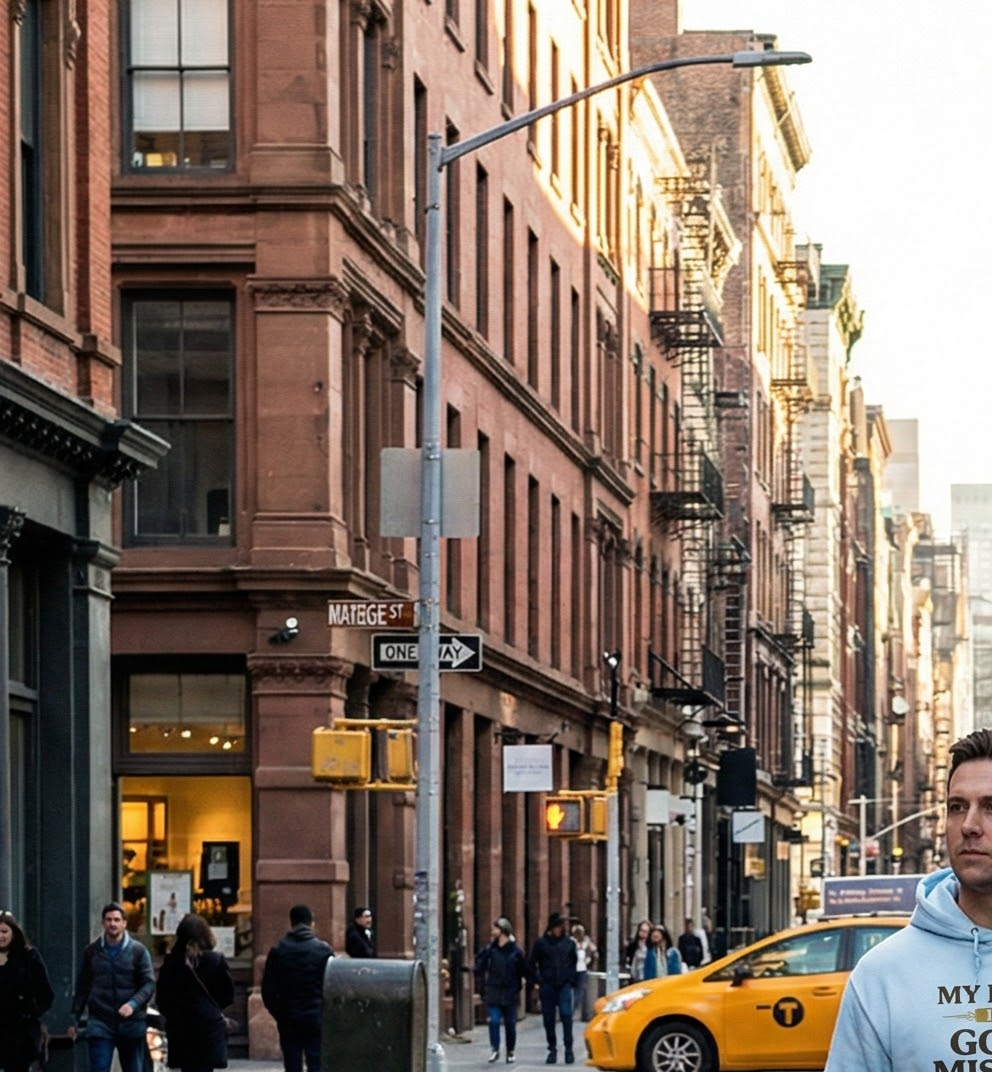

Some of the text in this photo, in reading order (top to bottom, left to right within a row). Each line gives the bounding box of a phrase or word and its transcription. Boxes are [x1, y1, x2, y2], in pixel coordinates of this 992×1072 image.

[389, 603, 404, 619] ST
[385, 645, 416, 659] ONE
[937, 984, 980, 1004] MY
